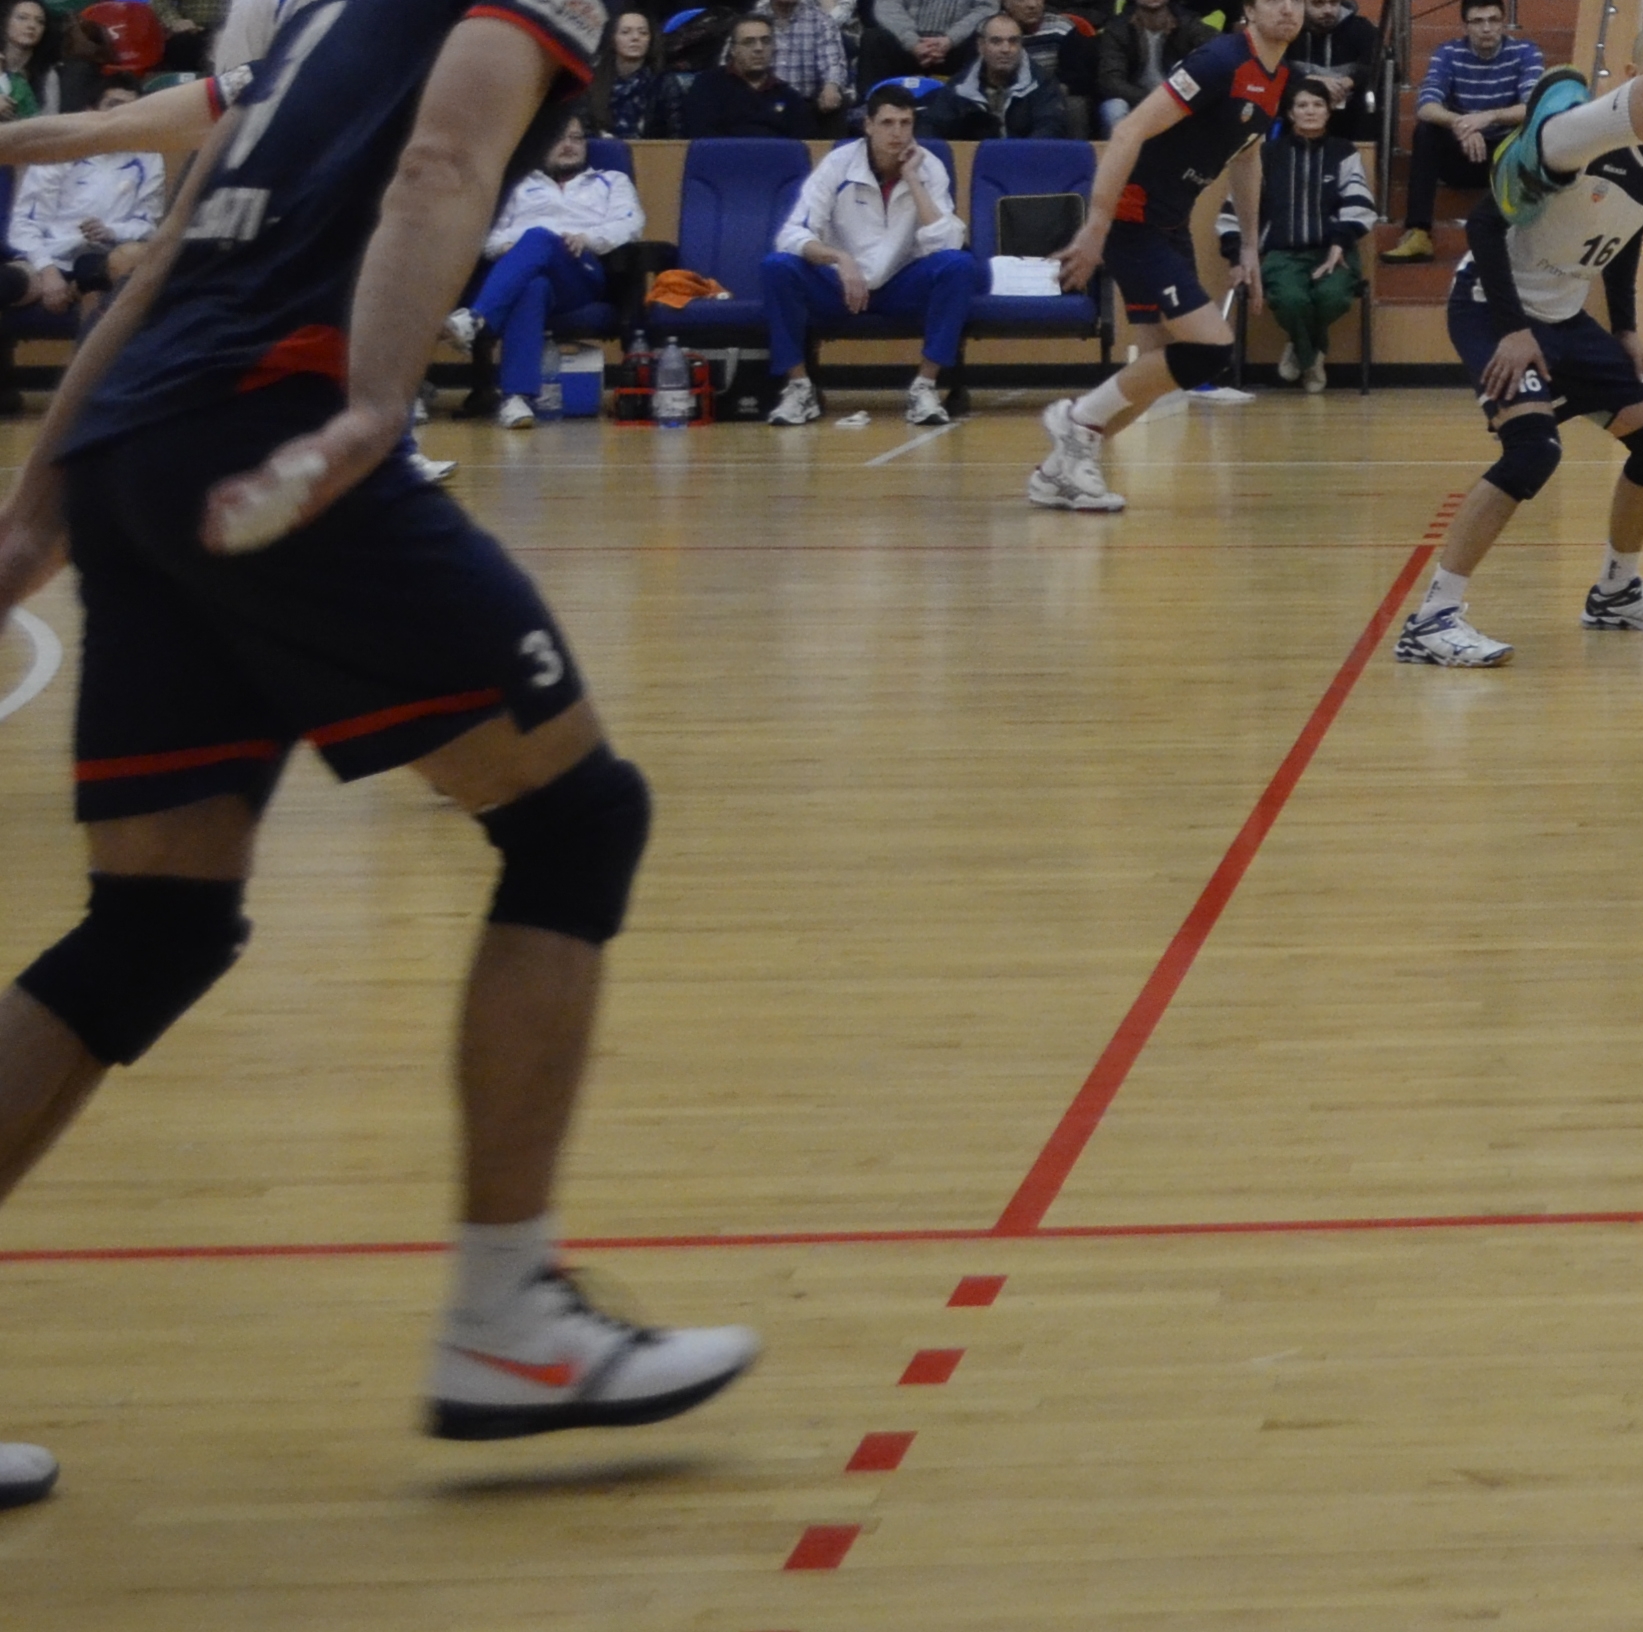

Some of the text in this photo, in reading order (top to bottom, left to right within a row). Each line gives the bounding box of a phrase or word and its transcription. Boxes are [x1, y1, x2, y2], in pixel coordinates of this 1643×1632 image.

[1578, 234, 1621, 267] 16
[1162, 284, 1180, 307] 7
[518, 629, 564, 688] 3
